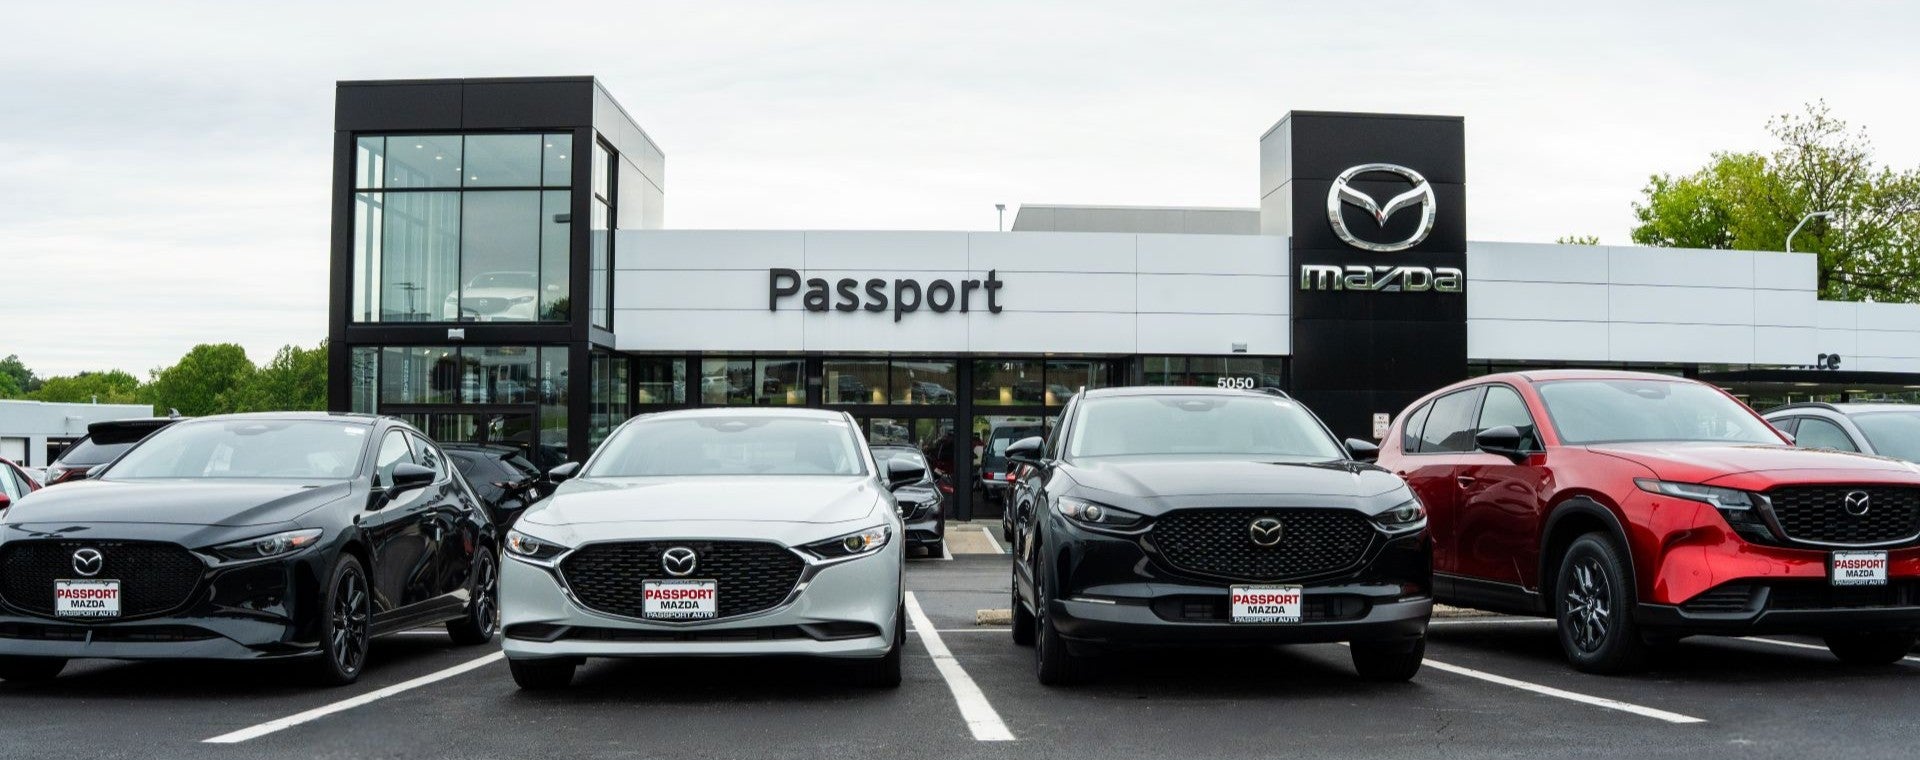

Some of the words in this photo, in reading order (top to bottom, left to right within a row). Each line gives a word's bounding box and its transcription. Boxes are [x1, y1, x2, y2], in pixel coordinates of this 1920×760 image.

[769, 268, 1003, 322] Passport
[1217, 376, 1255, 390] 5050
[1834, 559, 1885, 569] PASSPORT
[1845, 569, 1875, 577] MAZDA
[57, 589, 118, 599] PASSPORT
[645, 589, 714, 600] PASSPORT
[70, 600, 105, 608] MAZDA
[1233, 594, 1299, 605] PASSPORT
[660, 601, 700, 609] MAZDA
[1247, 605, 1286, 614] MAZDA
